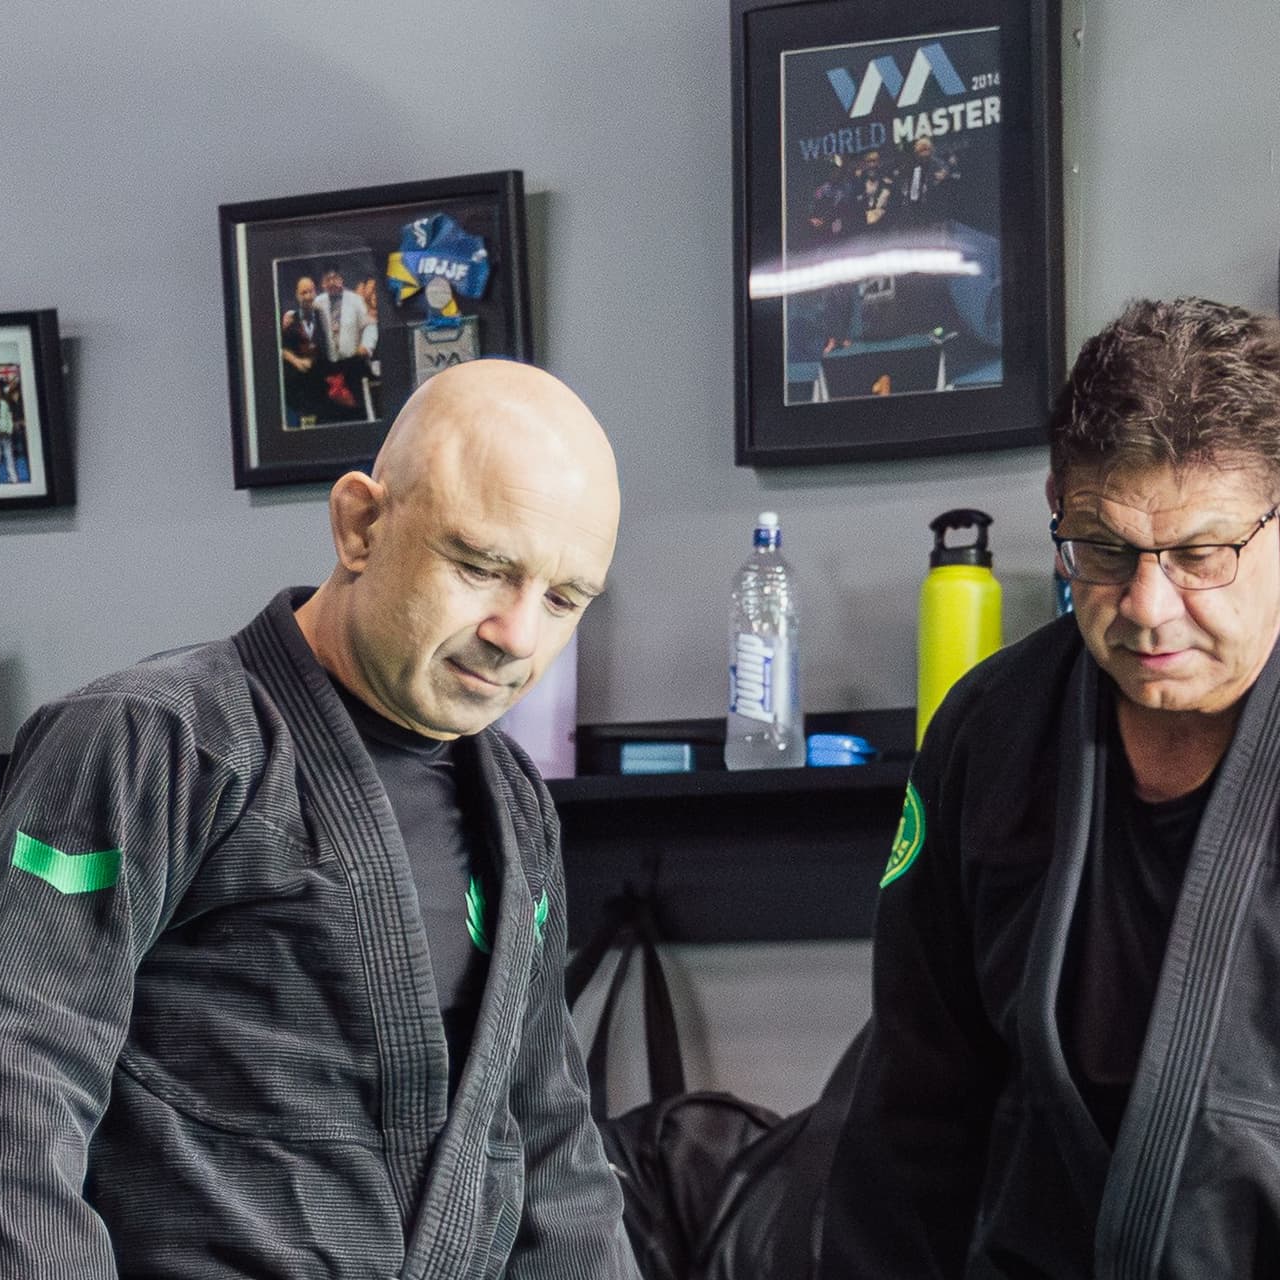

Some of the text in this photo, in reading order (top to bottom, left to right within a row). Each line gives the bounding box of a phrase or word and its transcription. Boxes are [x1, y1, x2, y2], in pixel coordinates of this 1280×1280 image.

[799, 96, 1001, 161] WORLD MASTER
[418, 257, 469, 281] IBJJF
